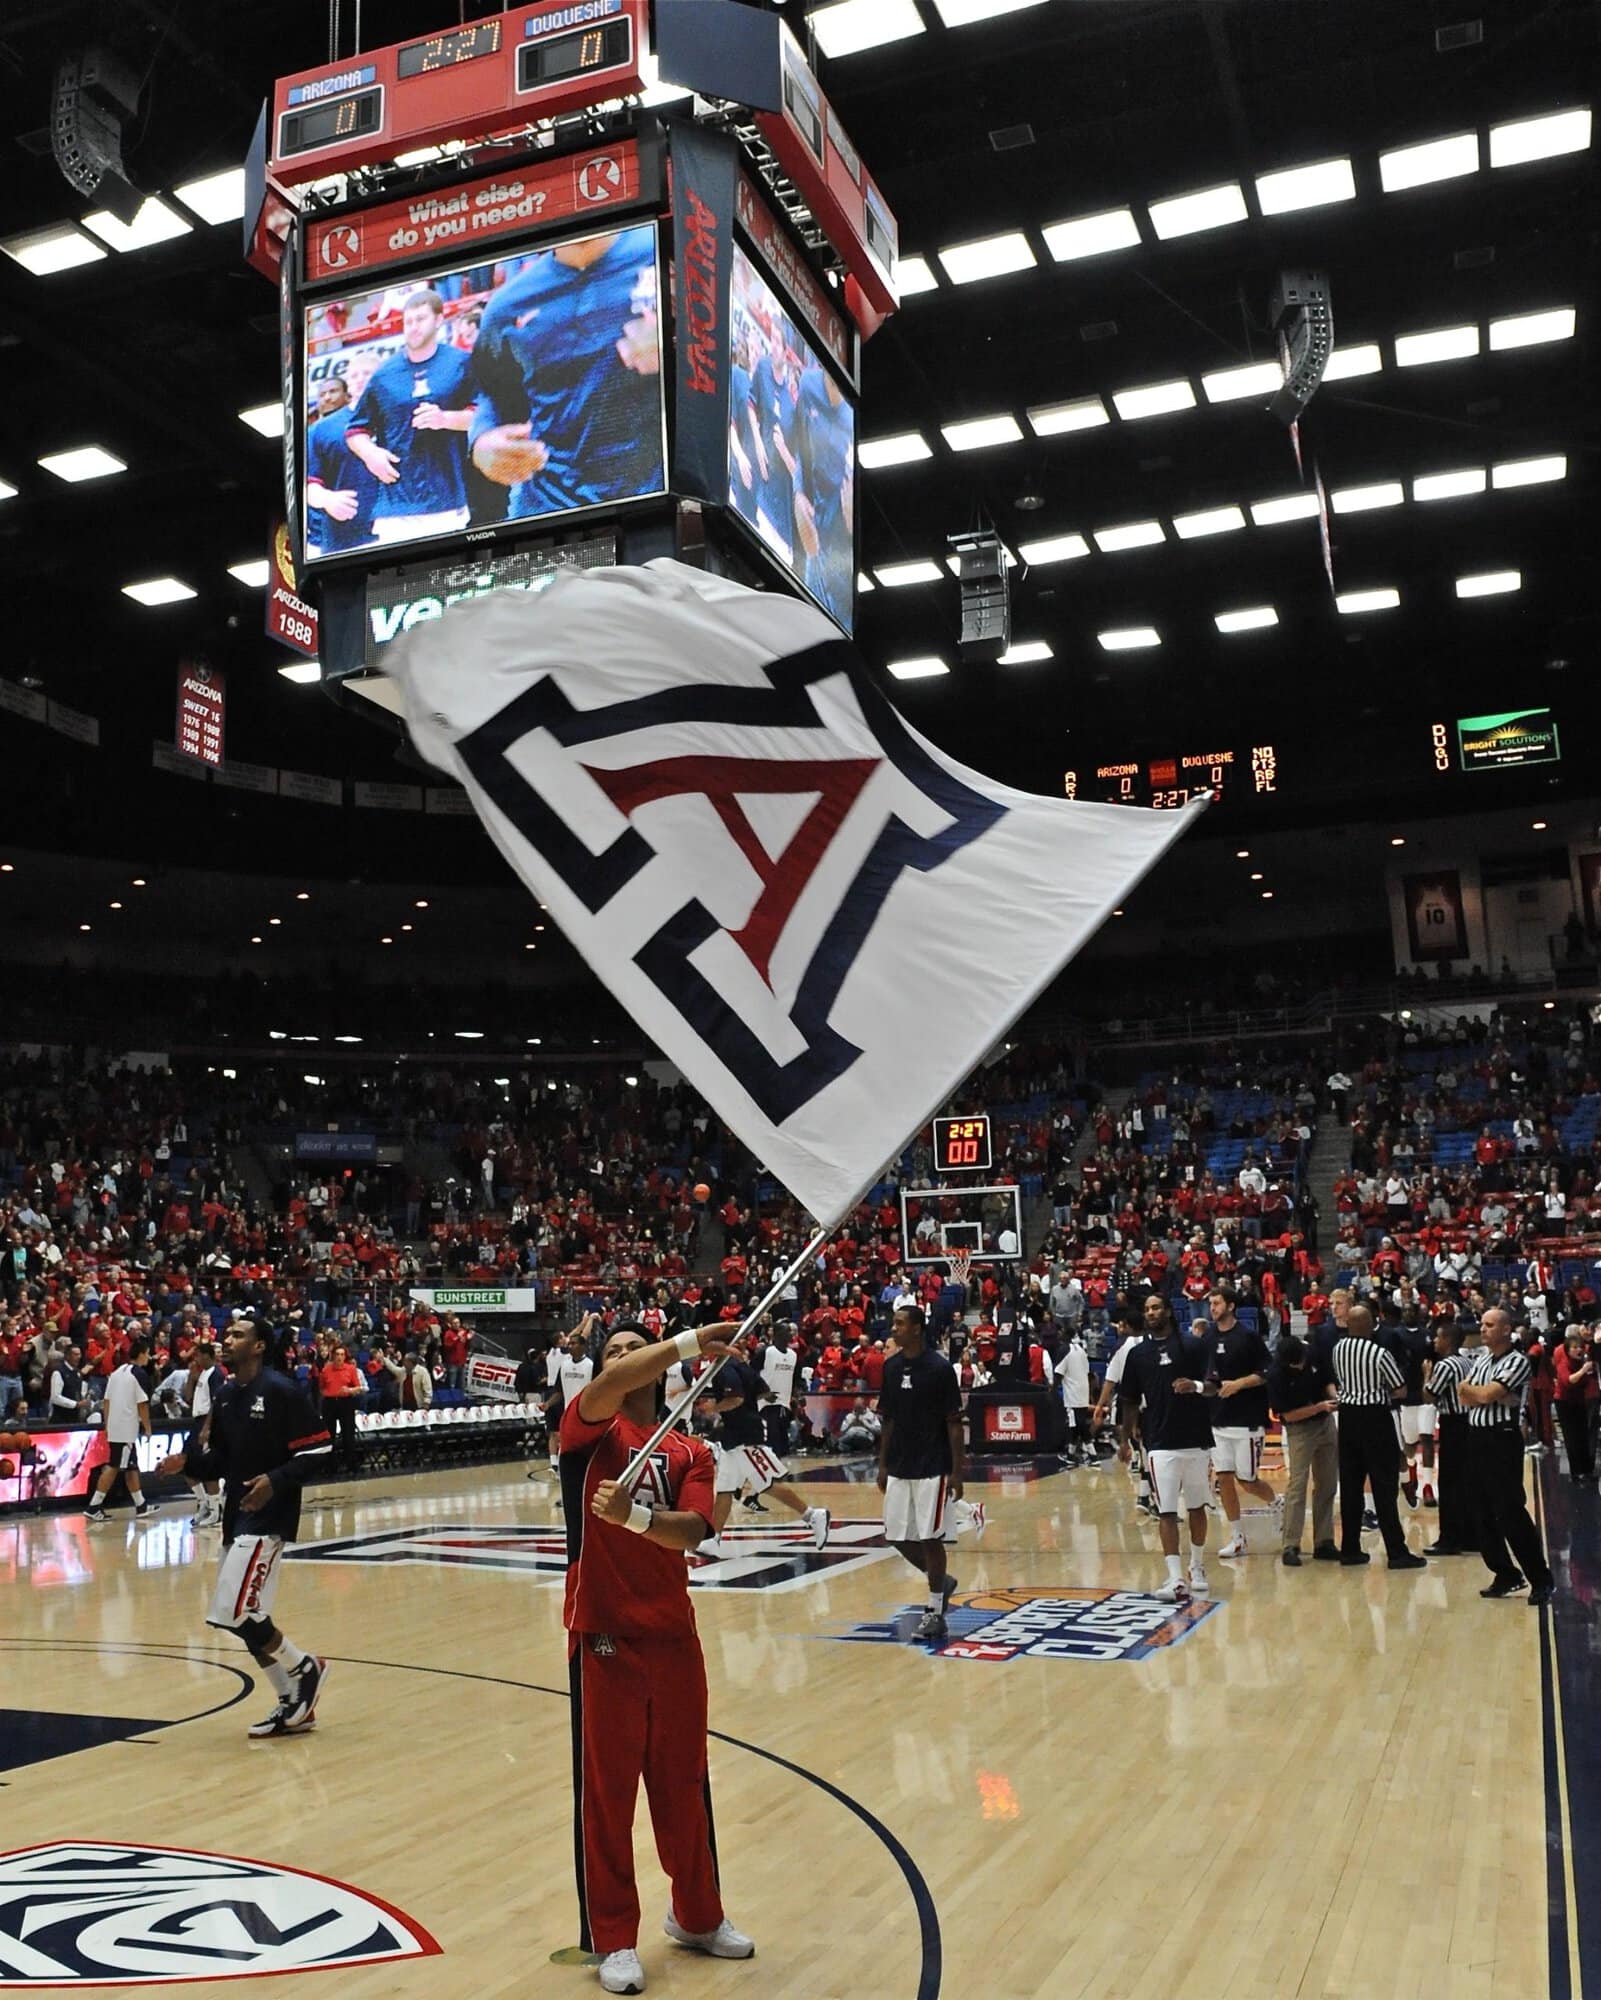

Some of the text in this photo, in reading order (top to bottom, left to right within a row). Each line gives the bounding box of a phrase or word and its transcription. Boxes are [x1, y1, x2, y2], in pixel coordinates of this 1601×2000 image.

[532, 0, 613, 35] DUQUESNE
[421, 20, 501, 72] 2:27
[302, 70, 362, 101] ARIZONA
[408, 181, 524, 224] What else
[388, 192, 546, 250] do you need?
[685, 187, 718, 394] ARIZONA
[272, 587, 320, 622] ARIZONA
[279, 613, 313, 646] 1988
[183, 677, 223, 704] ARIZONA
[183, 699, 209, 717] SWEET
[1464, 733, 1552, 751] BRIGHT SOLUTIONS
[1097, 764, 1138, 778] ARIZONA
[1182, 751, 1234, 768] DUQUESNE
[1252, 757, 1276, 770] PTS
[1152, 789, 1188, 808] 2:27
[949, 1122, 984, 1138] 2:27
[948, 1141, 978, 1163] 00
[436, 1291, 503, 1302] SUNSTREET
[471, 1361, 518, 1385] ESPN
[964, 1598, 1096, 1646] SPORTS
